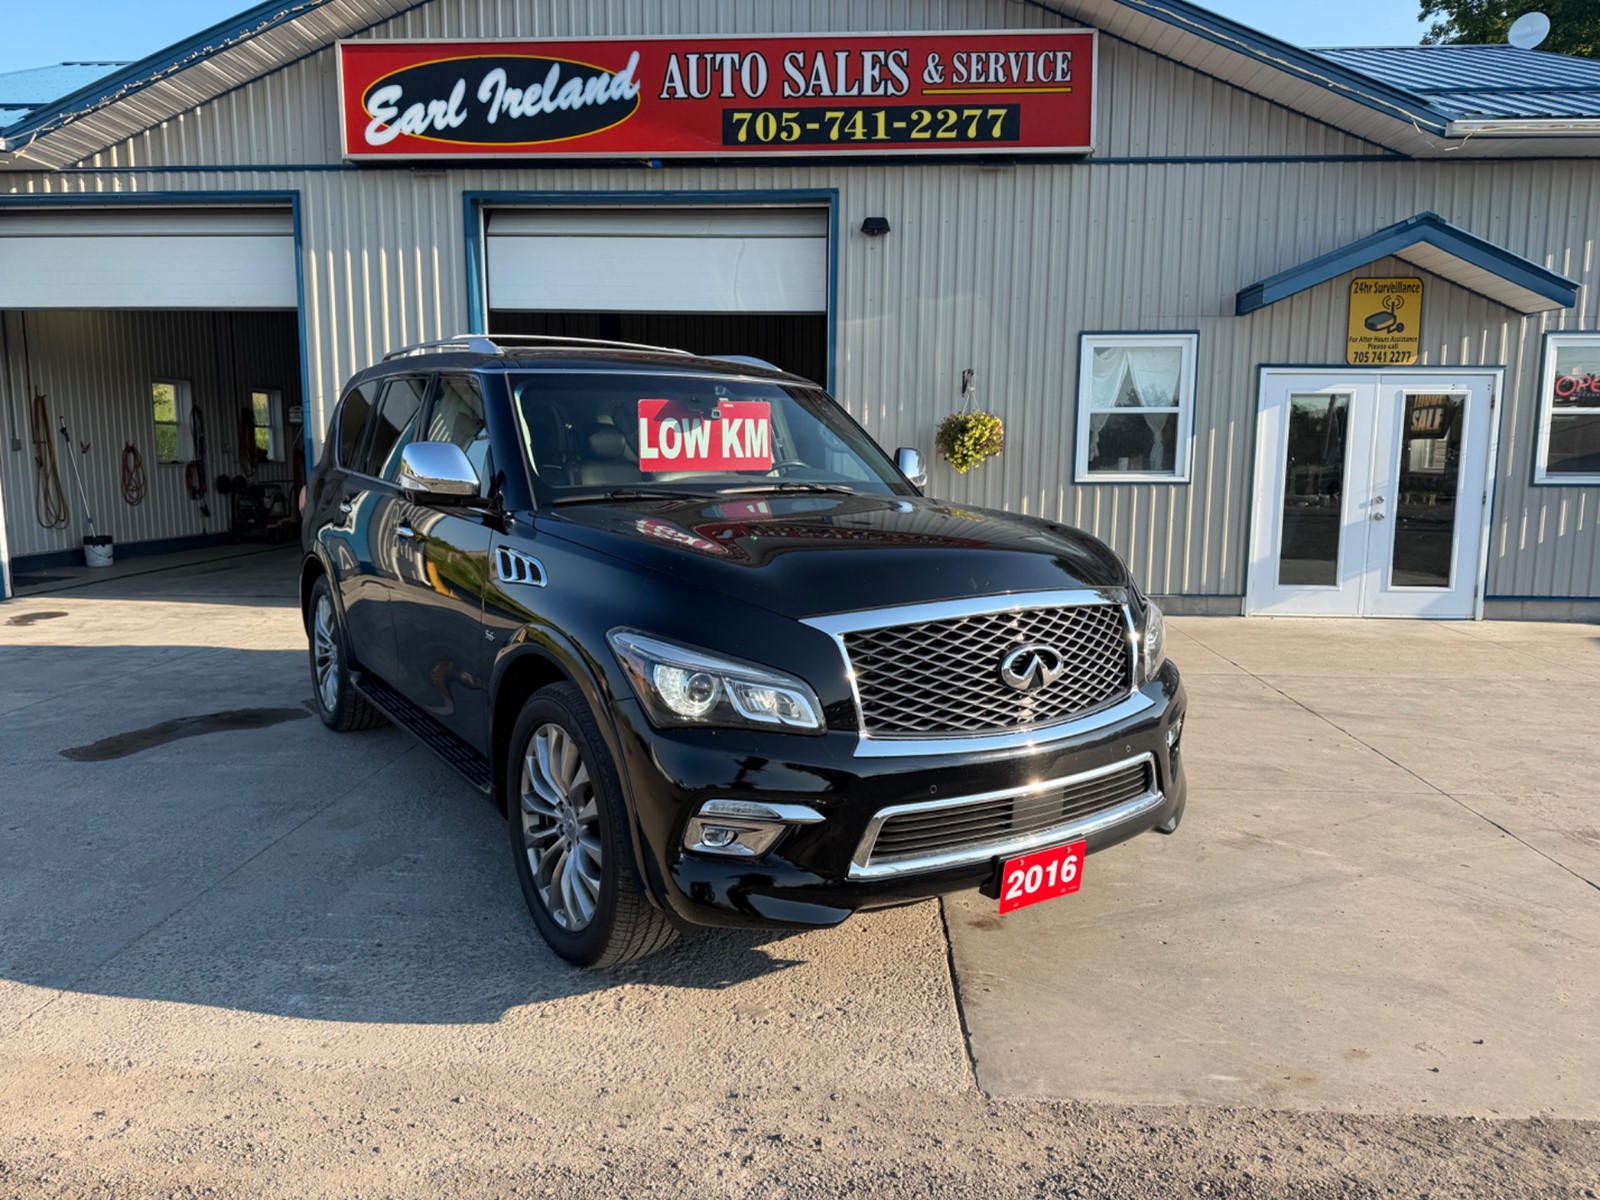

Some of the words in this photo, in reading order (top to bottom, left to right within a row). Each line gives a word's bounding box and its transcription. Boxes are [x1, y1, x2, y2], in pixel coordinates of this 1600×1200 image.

[659, 51, 769, 99] AUTO
[782, 48, 910, 98] SALES
[922, 52, 946, 84] &
[952, 50, 1072, 84] SERVICE
[364, 78, 467, 146] Earl
[477, 50, 640, 124] Ireland
[731, 108, 1008, 143] 705-741-2277
[1354, 281, 1372, 293] 24hr
[1374, 281, 1420, 293] Surveillance
[1353, 351, 1369, 363] 705
[1371, 351, 1387, 363] 741
[1389, 351, 1412, 363] 2277
[640, 417, 711, 459] LOW
[722, 418, 769, 458] KM
[1005, 854, 1078, 901] 2016
